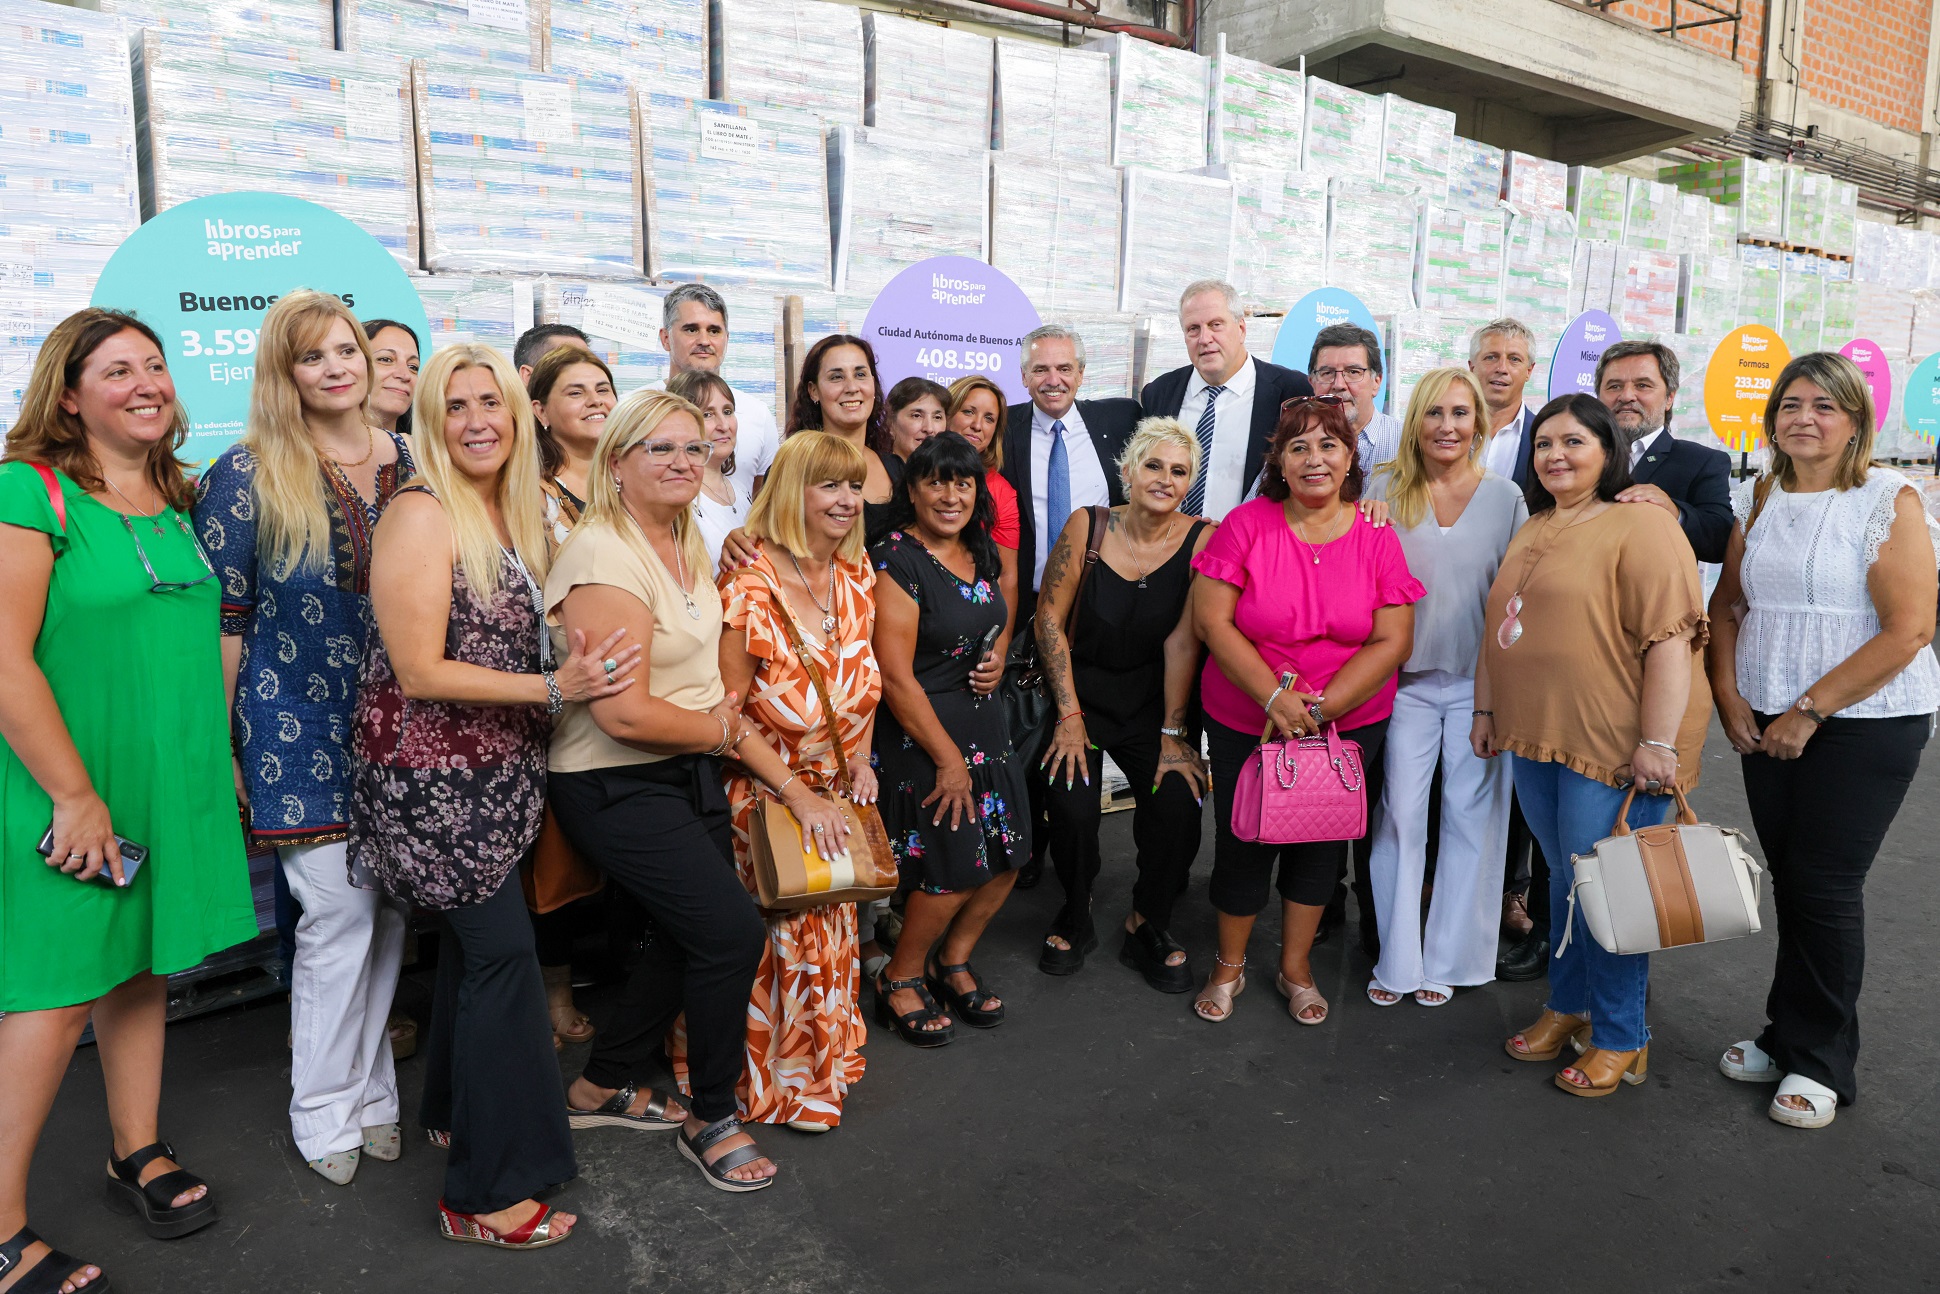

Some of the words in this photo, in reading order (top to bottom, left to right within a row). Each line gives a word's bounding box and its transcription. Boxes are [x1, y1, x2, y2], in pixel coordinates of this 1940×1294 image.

[714, 122, 747, 131] SANTILLANA
[205, 219, 272, 239] libros
[274, 228, 301, 238] para
[208, 240, 302, 261] aprender
[933, 273, 970, 291] libros
[970, 283, 986, 291] para
[179, 292, 279, 312] Buenos
[932, 289, 985, 305] aprender
[1316, 302, 1339, 314] libros
[632, 310, 648, 319] MATE
[1316, 314, 1349, 326] aprender
[1585, 321, 1600, 332] libros
[878, 326, 911, 338] Ciudad
[914, 330, 963, 342] Autónoma
[966, 333, 977, 343] de
[980, 335, 1013, 346] Buenos
[1584, 332, 1606, 342] aprender
[916, 348, 1001, 372] 408.590
[1739, 359, 1770, 368] Formosa
[1734, 376, 1772, 389] 233.230
[1736, 390, 1768, 400] Ejemplares
[204, 420, 243, 429] educación
